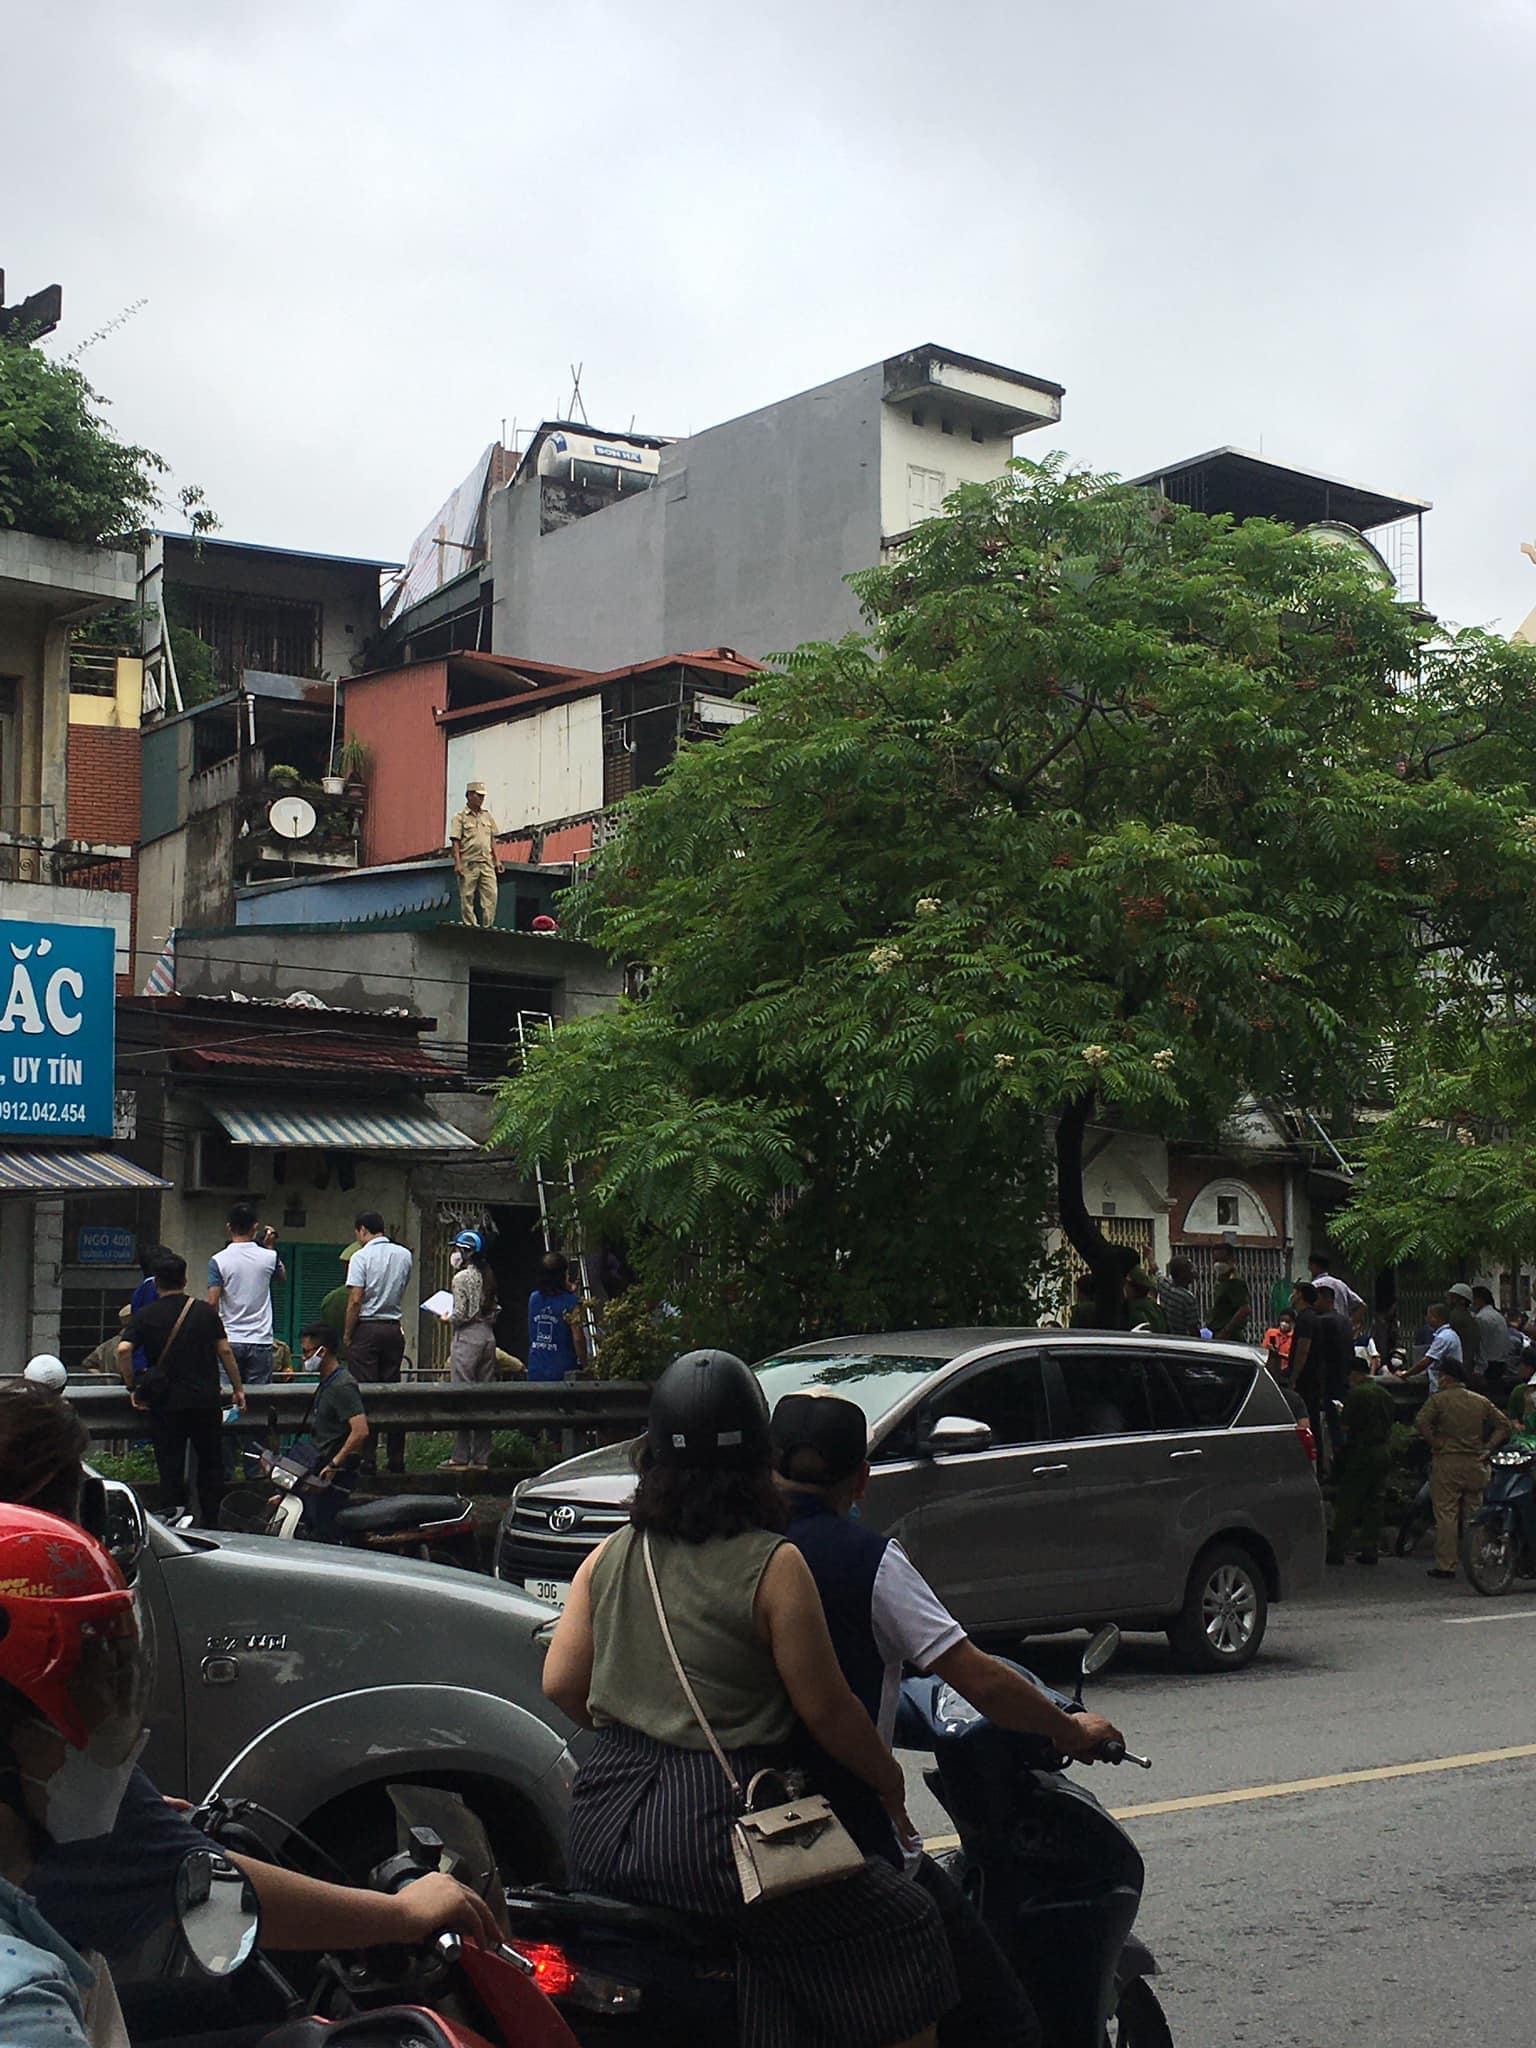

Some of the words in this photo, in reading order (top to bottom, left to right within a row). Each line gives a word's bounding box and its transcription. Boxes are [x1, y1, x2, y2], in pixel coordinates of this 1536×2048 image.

[13, 1056, 41, 1084] UY
[47, 1052, 83, 1086] TÍN
[0, 1101, 86, 1122] 912.042.454
[537, 1582, 558, 1599] 30G
